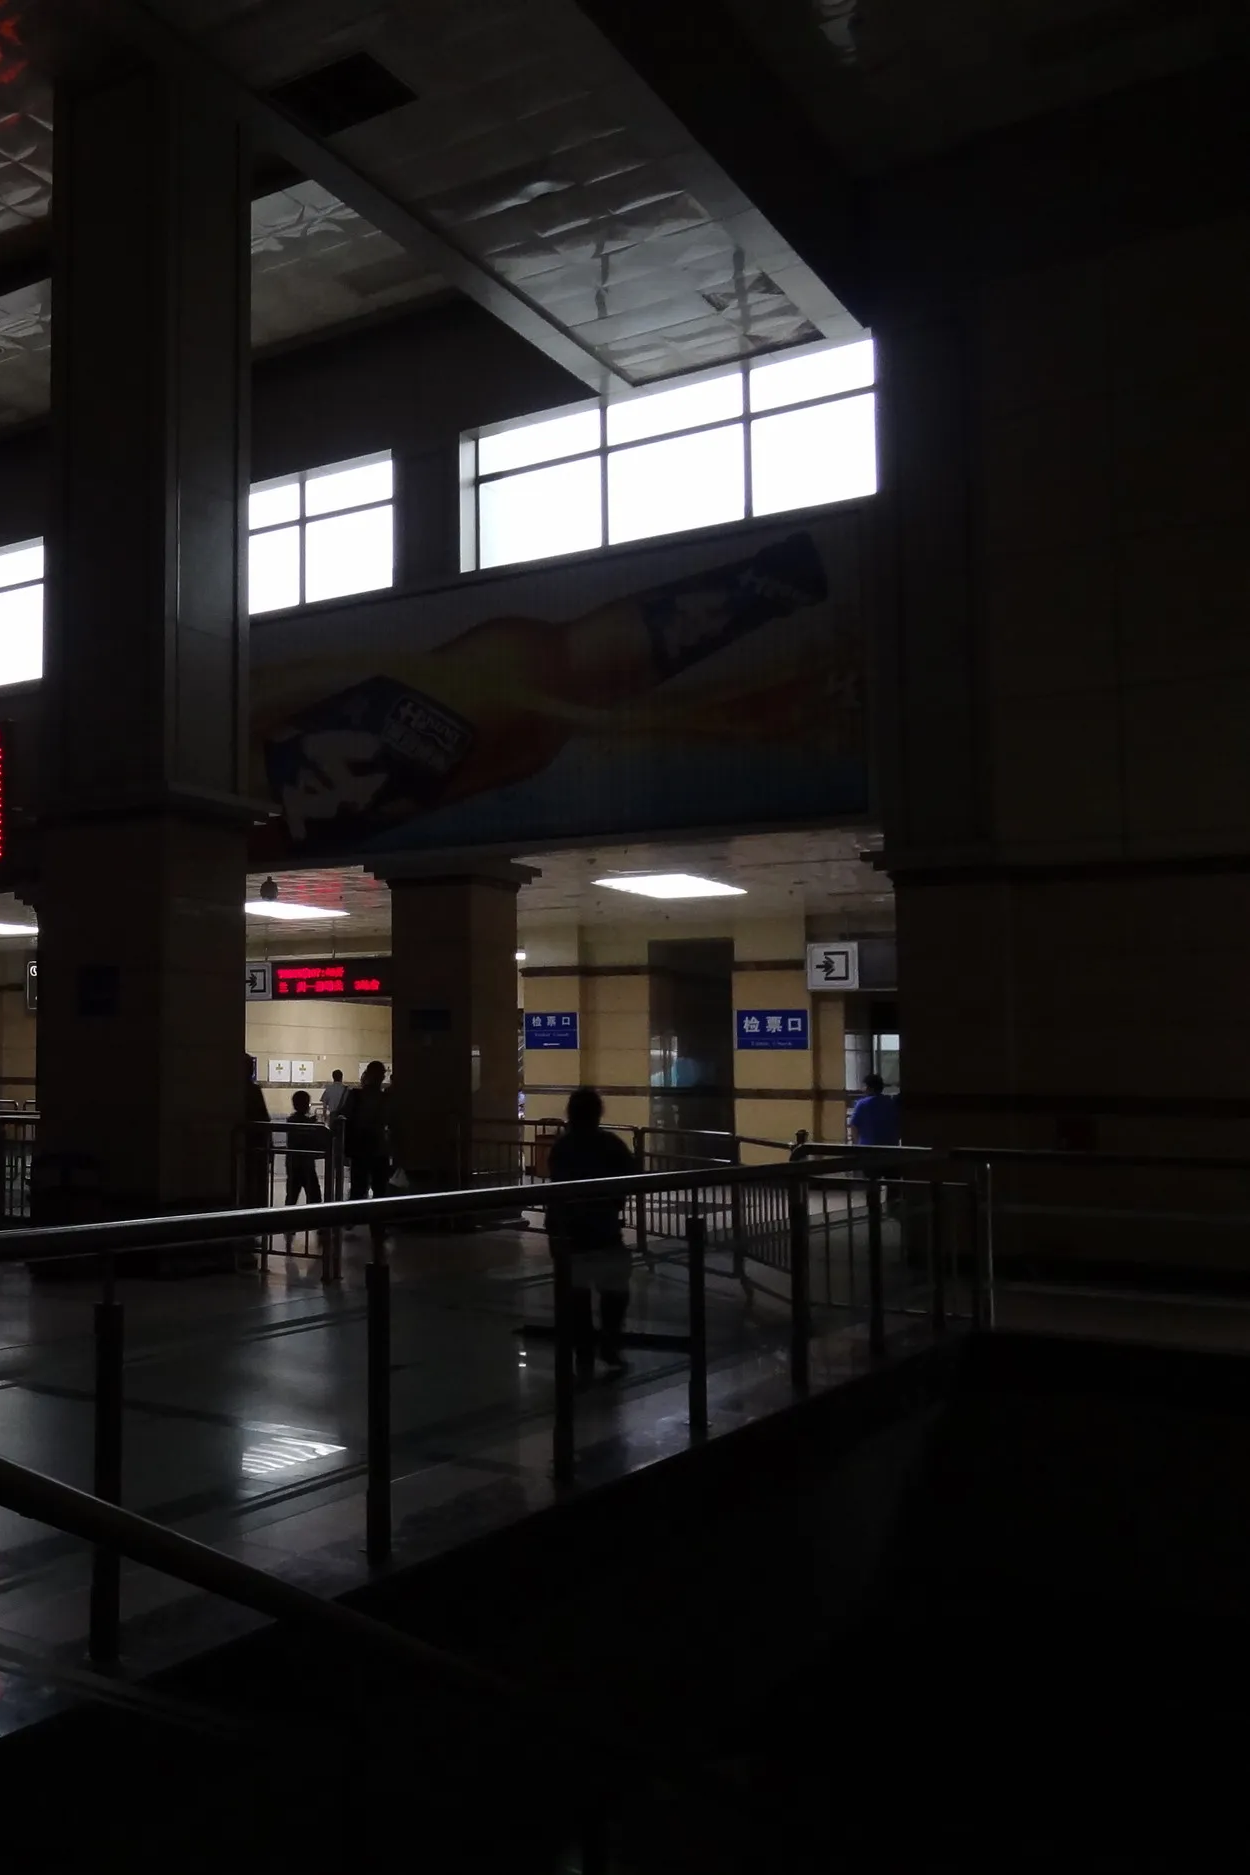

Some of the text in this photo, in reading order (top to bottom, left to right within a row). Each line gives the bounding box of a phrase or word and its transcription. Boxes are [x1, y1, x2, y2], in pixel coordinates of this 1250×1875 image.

[532, 1015, 571, 1027] 检票口
[743, 1016, 803, 1033] 检票口
